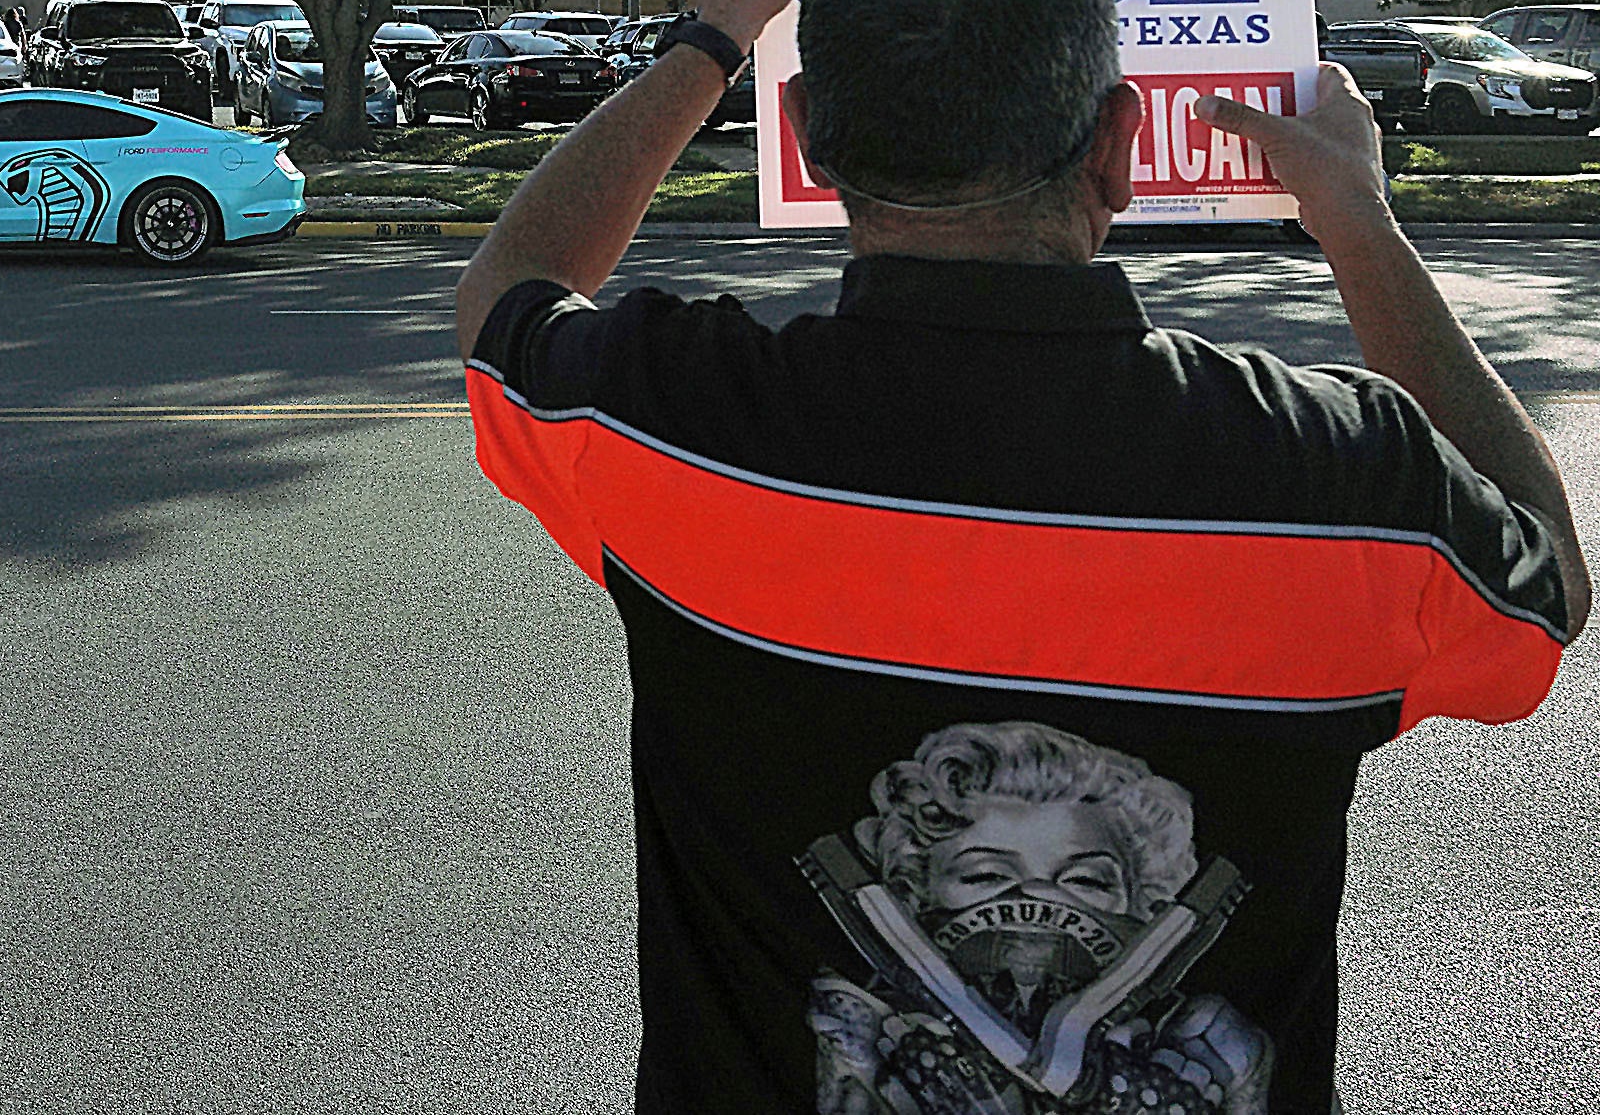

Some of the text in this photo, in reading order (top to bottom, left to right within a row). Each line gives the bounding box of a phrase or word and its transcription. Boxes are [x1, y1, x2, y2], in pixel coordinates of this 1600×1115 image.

[1130, 86, 1284, 183] LICAN
[124, 147, 209, 156] FORD PERFORMANCE
[376, 223, 442, 236] NO PARKING
[975, 902, 1082, 932] TRUMP
